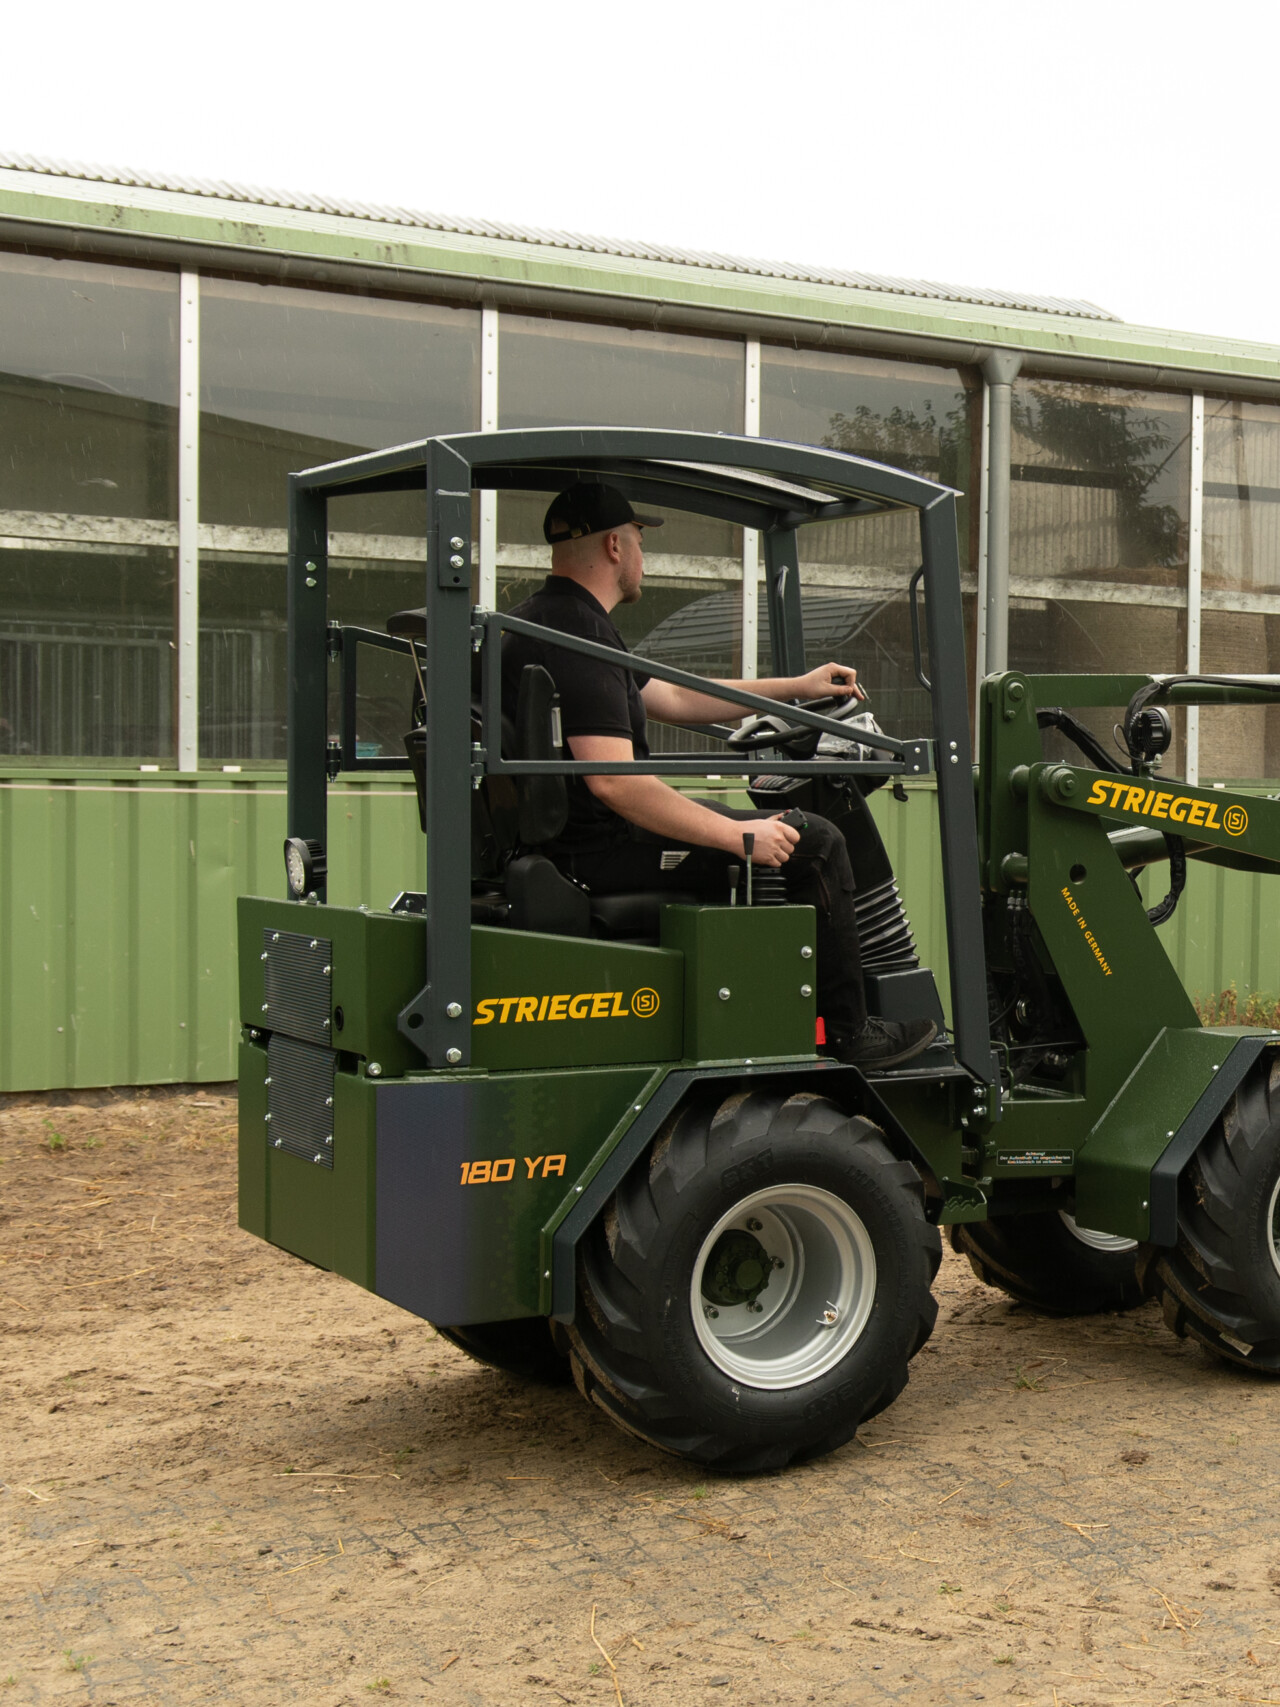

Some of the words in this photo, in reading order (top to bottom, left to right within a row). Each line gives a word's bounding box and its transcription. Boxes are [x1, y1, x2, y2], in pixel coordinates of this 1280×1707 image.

[1086, 779, 1221, 830] STRIEGEL
[1061, 887, 1080, 916] MADE
[1077, 917, 1087, 929] IN
[1084, 931, 1112, 976] GERMANY
[472, 992, 629, 1025] STRIEGEL
[460, 1159, 515, 1185] 180
[523, 1154, 567, 1179] YA
